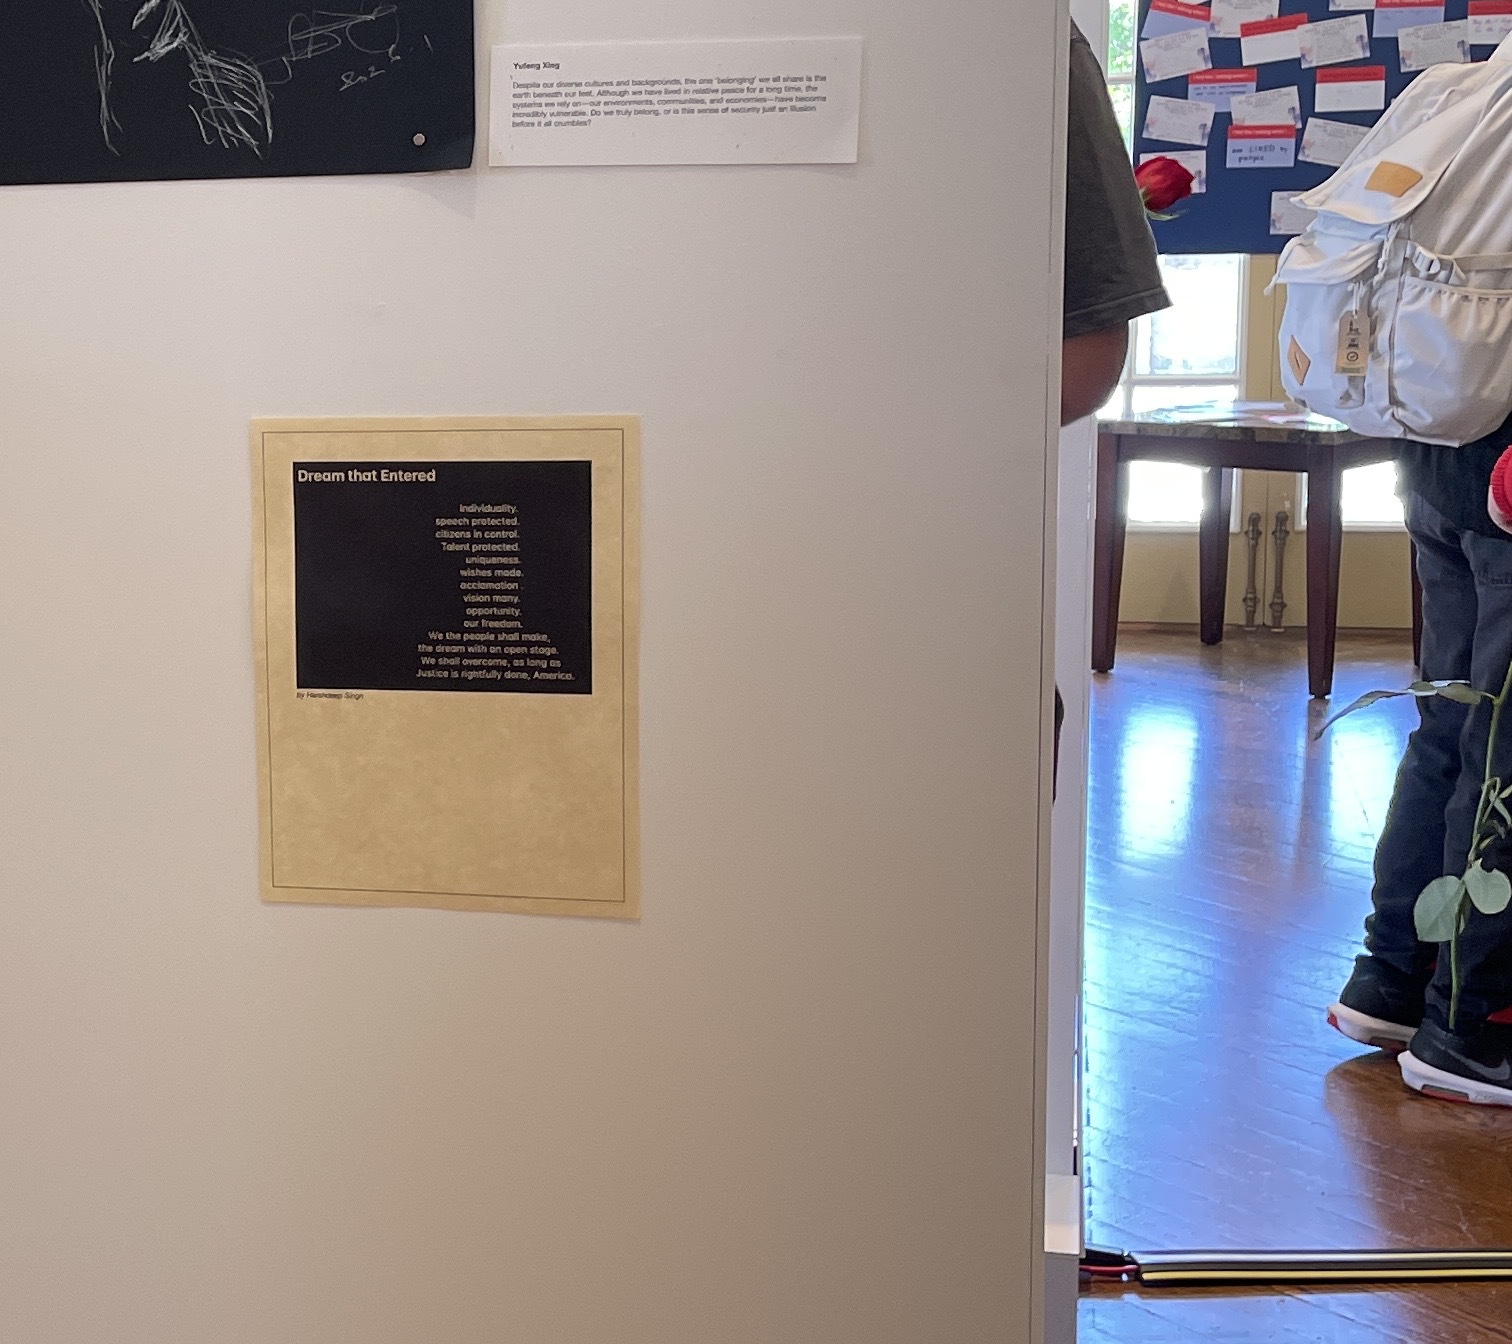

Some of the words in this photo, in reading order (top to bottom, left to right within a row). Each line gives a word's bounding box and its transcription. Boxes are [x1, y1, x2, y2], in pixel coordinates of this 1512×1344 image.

[297, 469, 344, 482] Dream
[347, 468, 377, 481] that
[380, 468, 435, 481] Entered
[435, 517, 469, 526] speech
[471, 516, 520, 527] protected.
[473, 528, 482, 538] in
[483, 529, 520, 538] control.
[440, 541, 470, 551] Talent
[471, 542, 520, 552] protected.
[459, 567, 492, 576] wishes
[494, 567, 524, 577] made.
[428, 630, 443, 640] We
[445, 631, 461, 640] the
[463, 631, 495, 642] people
[497, 631, 519, 641] shall
[521, 632, 550, 643] make,
[417, 643, 433, 652] the
[435, 643, 465, 652] dream
[466, 643, 487, 652] with
[503, 646, 527, 655] open
[420, 656, 436, 664] We
[437, 656, 460, 665] shall
[461, 658, 510, 667] overcome,
[526, 657, 547, 668] long
[549, 659, 561, 667] as
[415, 668, 448, 677] Justice
[450, 669, 459, 678] is
[504, 670, 531, 680] done,
[532, 670, 575, 680] America.
